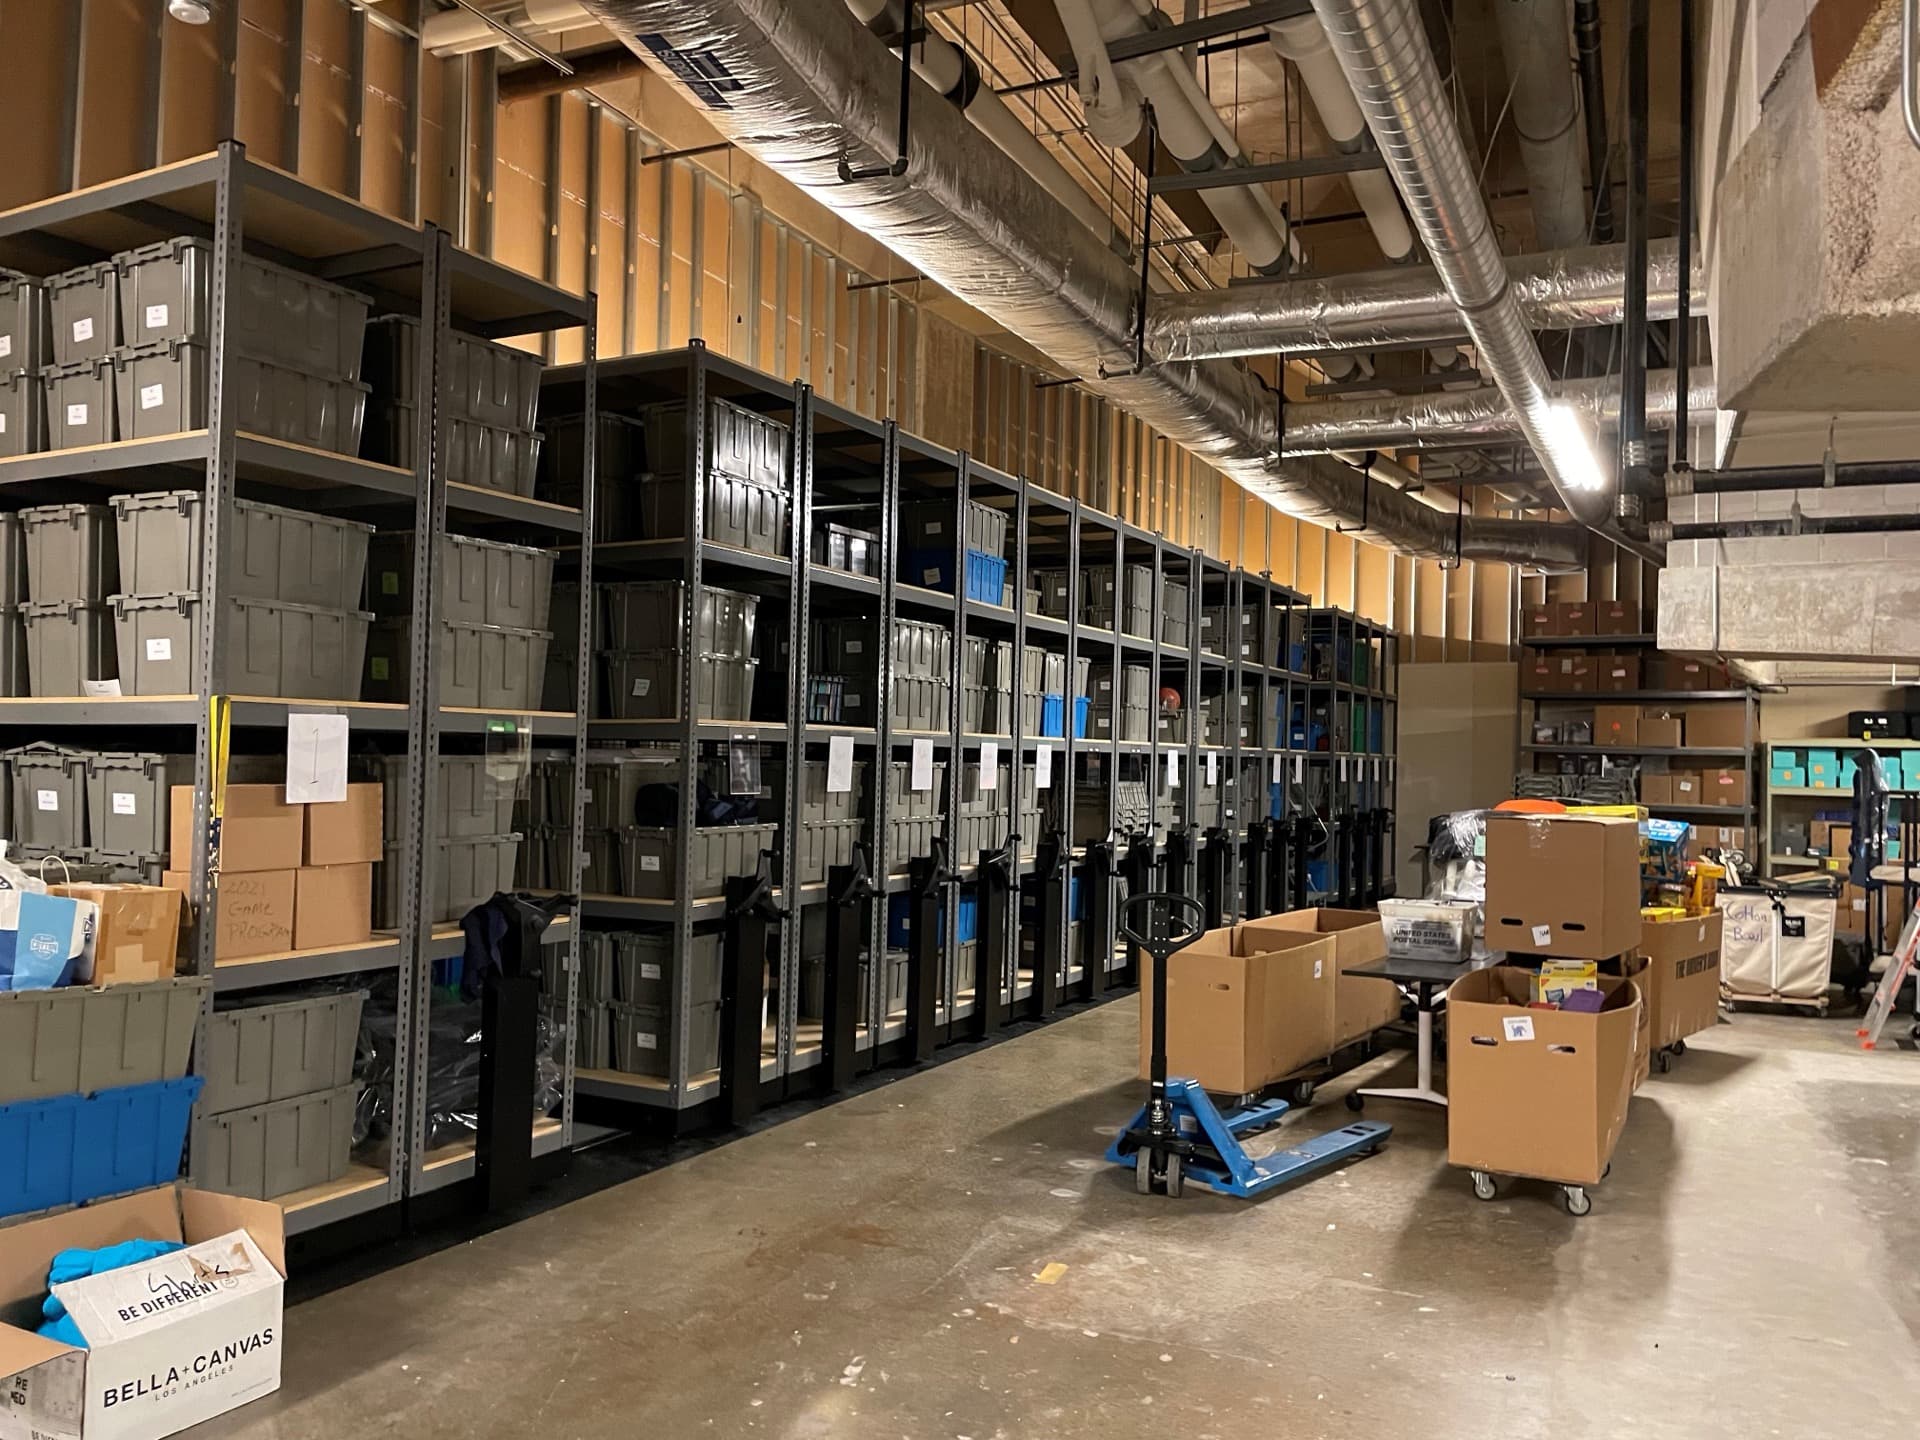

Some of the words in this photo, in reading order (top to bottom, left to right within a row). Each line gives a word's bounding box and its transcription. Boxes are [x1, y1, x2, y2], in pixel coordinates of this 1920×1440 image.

[1392, 937, 1421, 945] POSTAL
[1396, 929, 1422, 938] UNITED
[1423, 931, 1452, 940] STATES
[117, 1304, 140, 1321] BE
[140, 1281, 219, 1314] DIFFERENT
[154, 1386, 178, 1403] LOS
[184, 1363, 234, 1391] ANGELES
